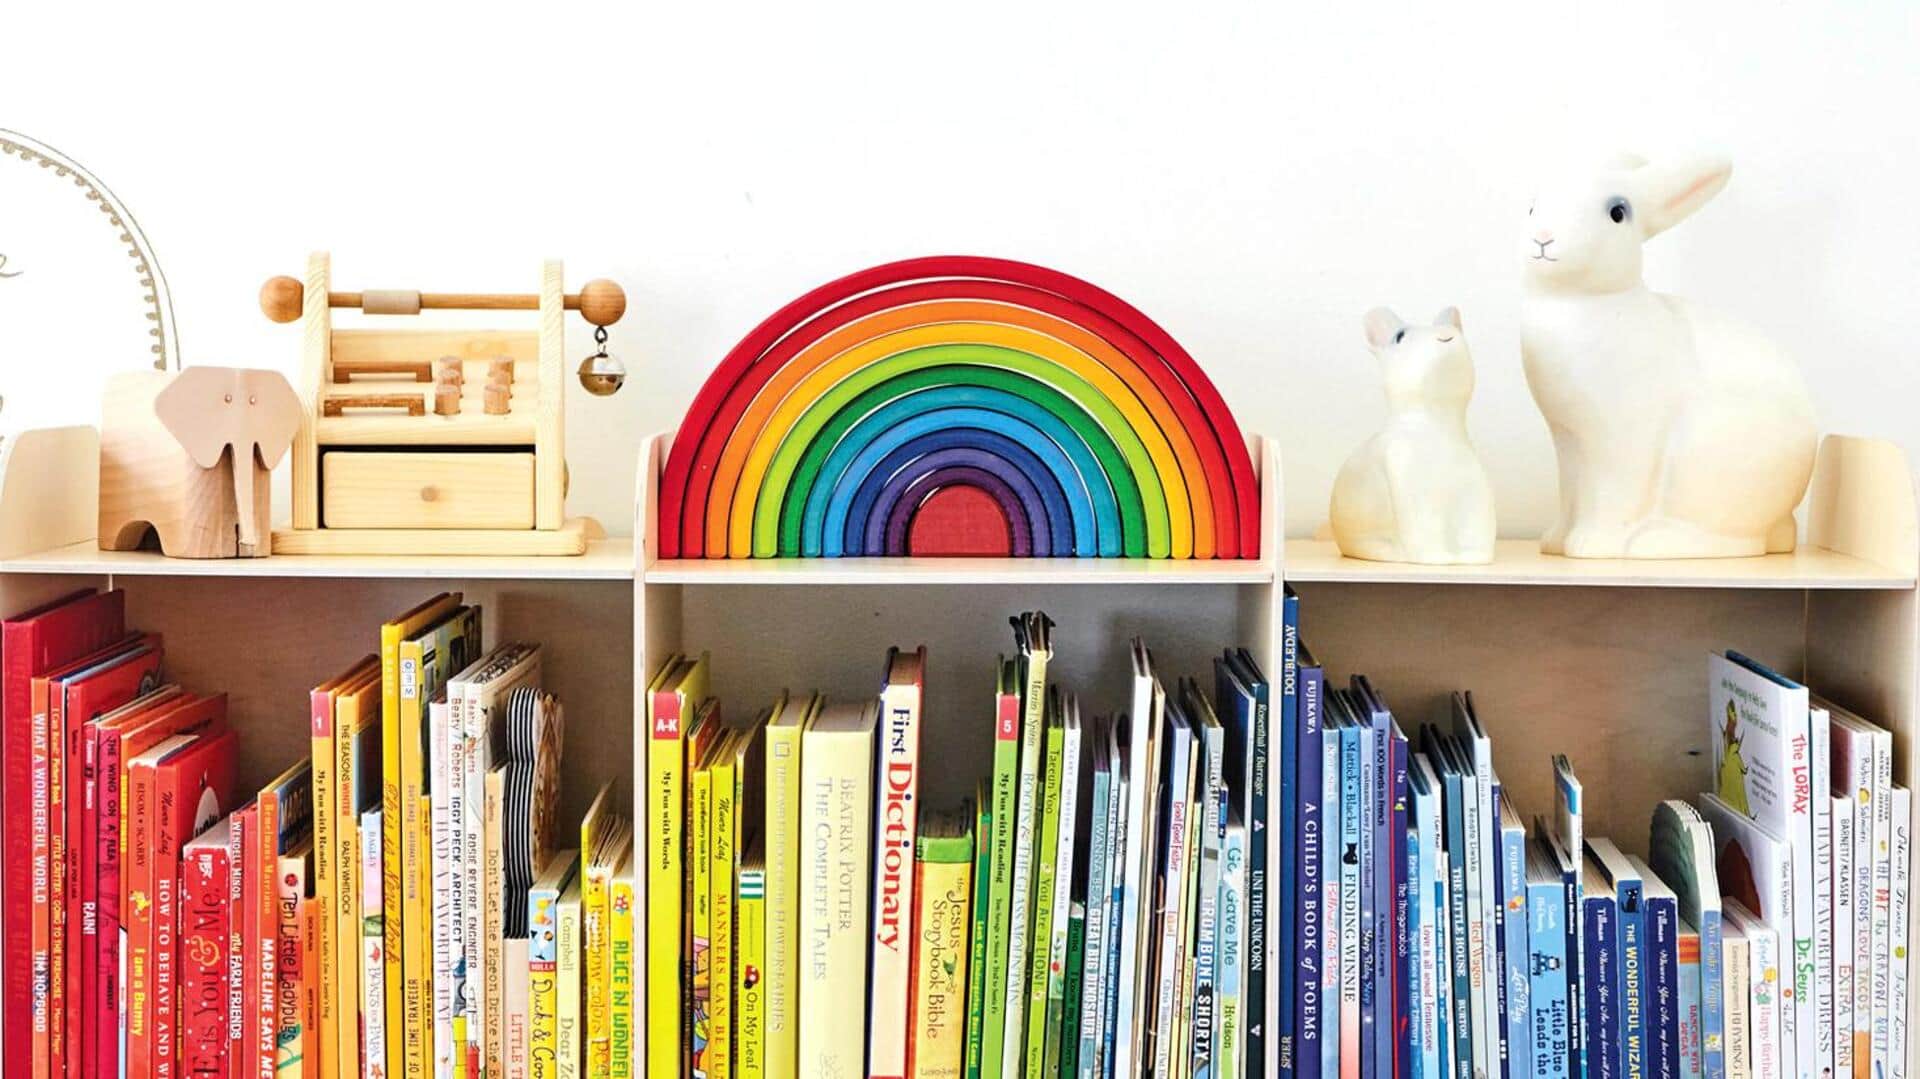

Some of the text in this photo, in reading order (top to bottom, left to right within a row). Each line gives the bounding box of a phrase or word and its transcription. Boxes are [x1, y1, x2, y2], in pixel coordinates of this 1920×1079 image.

[1284, 624, 1296, 696] DOUBLEDAY
[451, 698, 463, 789] Beaty Roberts
[655, 719, 678, 732] A-K
[1256, 704, 1267, 748] Rosenthal
[1306, 680, 1318, 735] FUJIKAWA
[1376, 728, 1386, 747] First
[107, 739, 117, 861] THE WING ON A FLEA
[341, 725, 351, 817] THE SEASONS WINTER
[1345, 741, 1358, 835] Mattick Blackall
[1792, 733, 1809, 816] The LORAX
[34, 713, 46, 904] WHAT A WONDERFUL WORLD
[159, 830, 173, 857] Leaf
[662, 811, 672, 835] with
[878, 708, 913, 952] First Dictionary
[999, 813, 1008, 837] with
[1169, 801, 1184, 872] Good Good Father
[1376, 800, 1386, 827] French
[136, 827, 145, 868] SCARRY
[232, 868, 242, 900] MINOR
[342, 841, 351, 915] RALPH WHITLOCK
[452, 796, 462, 945] IGGY ARCHITECT
[716, 836, 729, 861] Leaf
[1408, 854, 1418, 896] Eric Hill
[1510, 845, 1519, 892] FUJIKAWA
[1876, 859, 1889, 881] THE
[83, 902, 96, 935] RAIN!
[437, 821, 450, 1024] HAD FAVORITE HAT
[467, 833, 477, 969] ROSIE ENGINEER
[946, 890, 967, 949] Jesus
[1250, 870, 1264, 971] UNI THE UNICORN
[1301, 803, 1317, 1041] A CHILD'S BOOK of POEMS
[1397, 883, 1407, 898] The
[1452, 867, 1466, 978] THE LITTLE HOUSE
[1875, 888, 1890, 912] DAY
[280, 892, 299, 965] Ten Little
[486, 850, 499, 1062] Don't Let the Pigeon Drive the
[1033, 878, 1050, 987] You Are a LION!
[1086, 907, 1102, 970] GREAT BIG
[1225, 940, 1238, 966] Me
[1344, 873, 1356, 1003] FINDING WINNIE
[1469, 921, 1483, 988] Red Wagon
[1817, 826, 1832, 1054] HAD A FAVORITE DRESS
[1857, 866, 1870, 1012] DRAGONS LOVE TACOS
[34, 949, 46, 1033] TIM HOPGOOD
[134, 957, 143, 977] am
[159, 879, 170, 1057] HOW TO BEHAVE AND
[194, 971, 220, 1017] You
[230, 955, 242, 1040] FARM FRIENDS
[261, 939, 275, 1052] MADELINE SAYS
[531, 979, 552, 1026] Duck
[560, 916, 574, 1059] Campbell Dear
[714, 893, 727, 1045] MANNERS CAN BE
[923, 899, 948, 1040] Storybook Bible
[1196, 896, 1215, 1061] TROMBONE SHORTY
[1408, 930, 1420, 1008] Spot Goes to the
[1423, 924, 1436, 1052] Love all Tennessee
[1626, 923, 1640, 1033] THE WONDERFUL
[1796, 937, 1815, 1003] Dr. Seuss
[130, 992, 146, 1036] Bunny
[408, 978, 420, 1074] OF A TIME TRAVELER
[511, 1013, 522, 1062] LITTLE
[534, 1029, 552, 1041] &
[742, 992, 759, 1070] On My Leaf
[1457, 999, 1468, 1039] BURTON
[1536, 1007, 1551, 1076] Leads the
[1552, 999, 1566, 1073] Little Blue
[1837, 965, 1853, 1068] EXTRA YARN
[1280, 1036, 1292, 1069] SPIER
